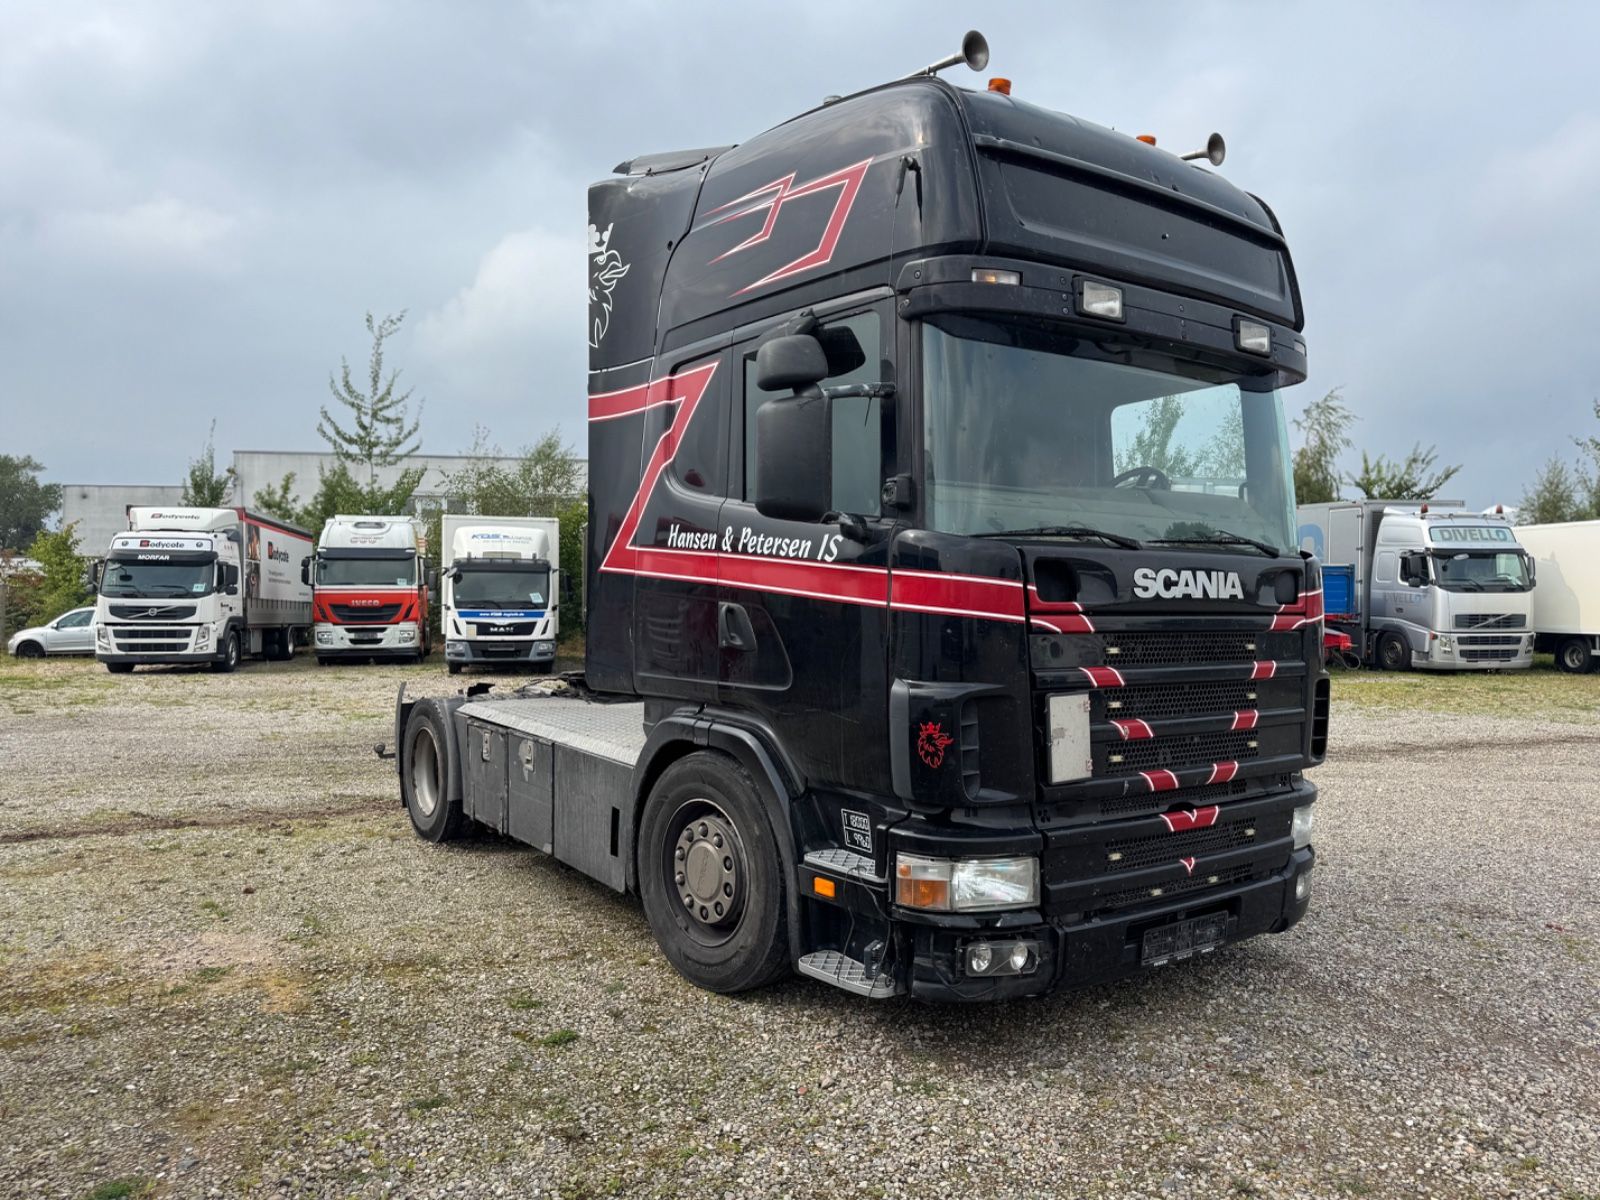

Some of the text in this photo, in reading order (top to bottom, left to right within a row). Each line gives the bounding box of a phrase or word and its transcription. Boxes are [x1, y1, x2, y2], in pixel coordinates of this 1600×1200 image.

[1439, 528, 1508, 541] DIVELLO
[139, 540, 185, 549] Bodycote
[667, 524, 718, 550] Hansen
[721, 525, 734, 553] &
[738, 526, 812, 559] Petersen
[1133, 567, 1244, 599] SCANIA
[351, 599, 380, 607] IVECO
